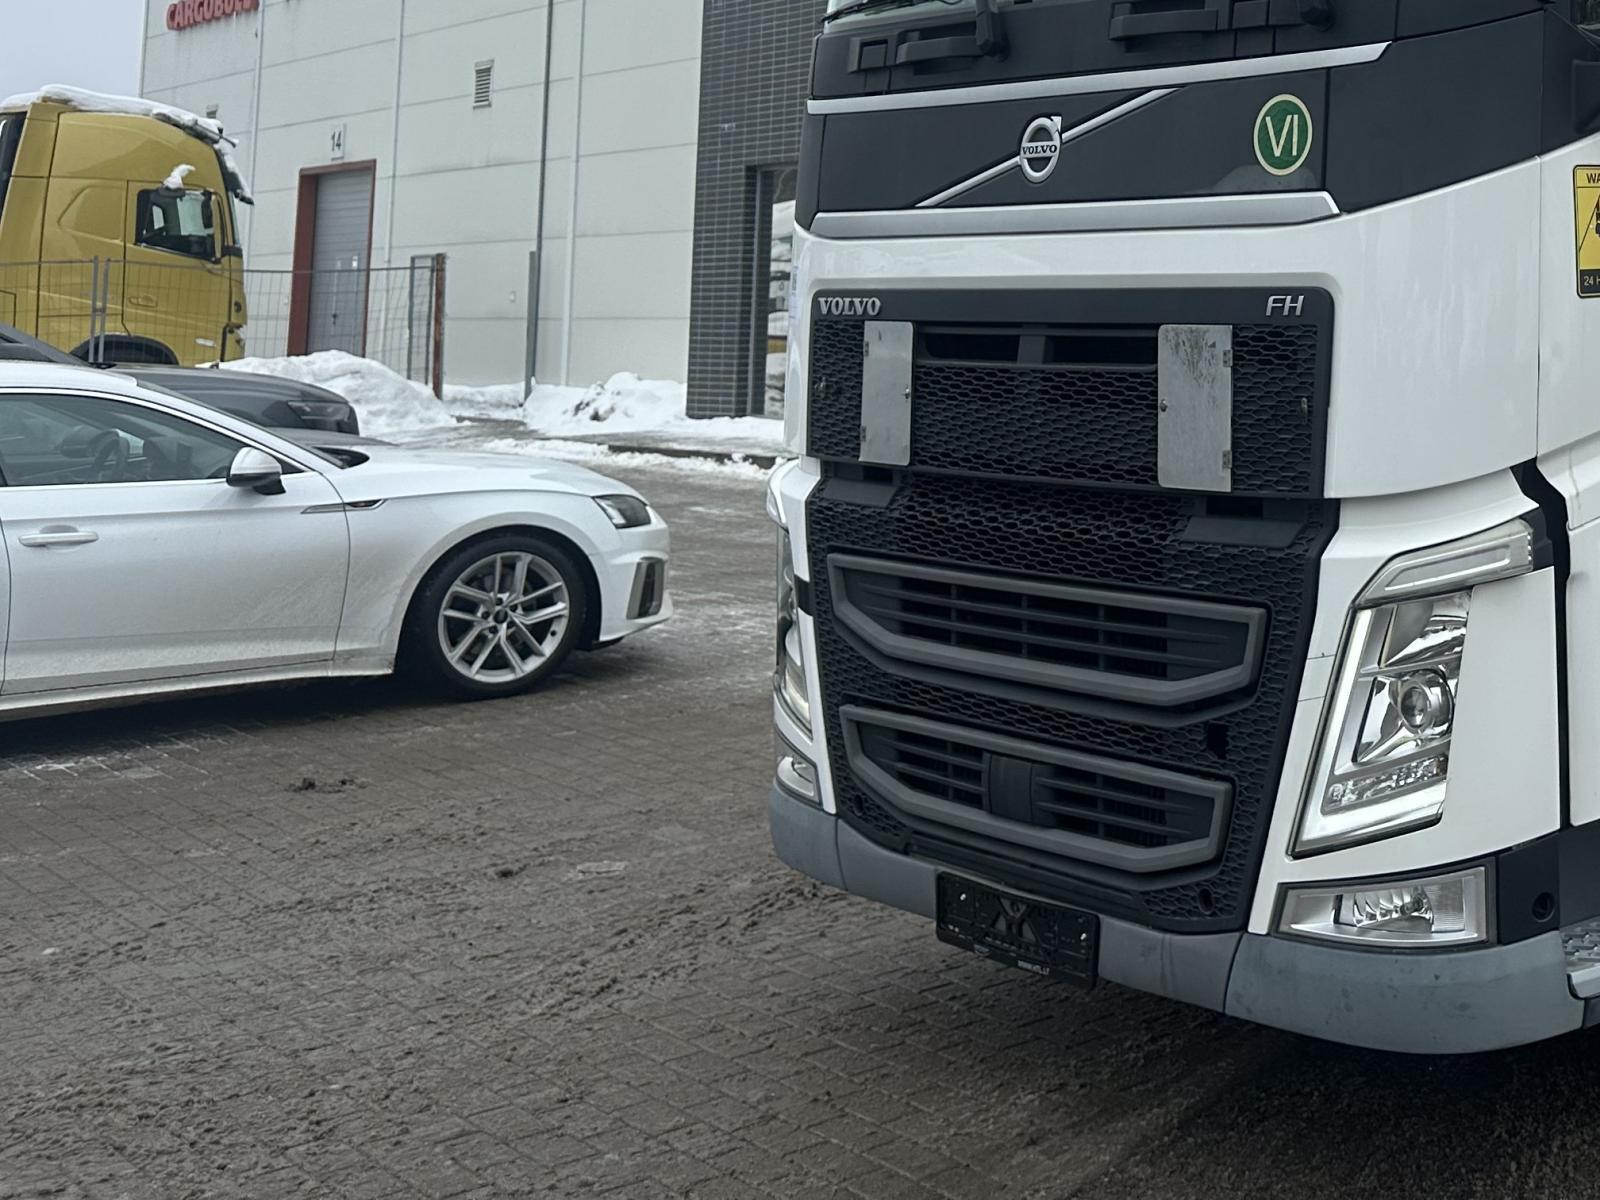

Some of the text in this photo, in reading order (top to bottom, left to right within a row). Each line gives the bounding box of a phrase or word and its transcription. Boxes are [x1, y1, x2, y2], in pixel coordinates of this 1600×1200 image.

[331, 130, 342, 152] 14
[1265, 114, 1299, 159] VI
[1021, 144, 1059, 157] VOLVO
[1583, 275, 1594, 286] 24
[818, 296, 882, 317] VOLVO
[1265, 294, 1305, 318] FH
